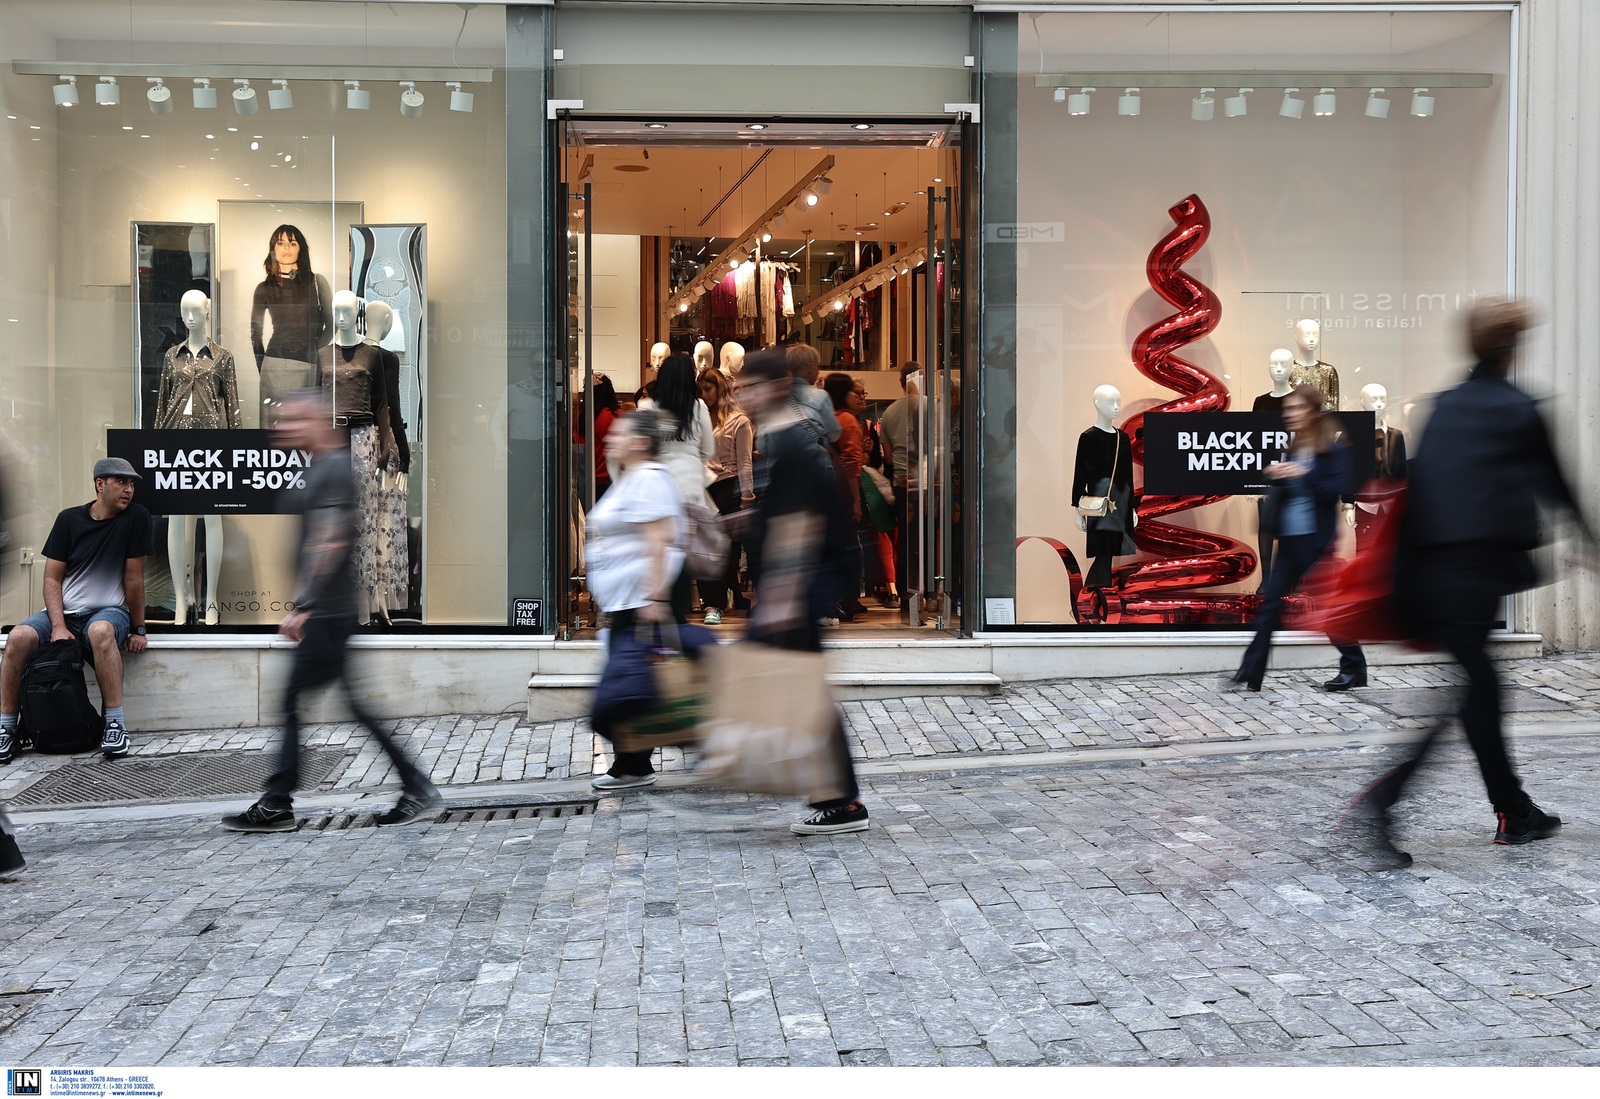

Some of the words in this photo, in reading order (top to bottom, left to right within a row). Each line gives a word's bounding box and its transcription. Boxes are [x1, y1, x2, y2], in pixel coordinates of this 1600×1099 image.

[1177, 431, 1253, 450] BLACK
[143, 449, 224, 468] BLACK
[232, 449, 315, 468] FRIDAY
[242, 471, 307, 490] -50%
[192, 601, 297, 612] MANGO.CO
[516, 602, 539, 610] SHOP
[516, 610, 533, 618] TAX
[516, 618, 536, 626] FREE
